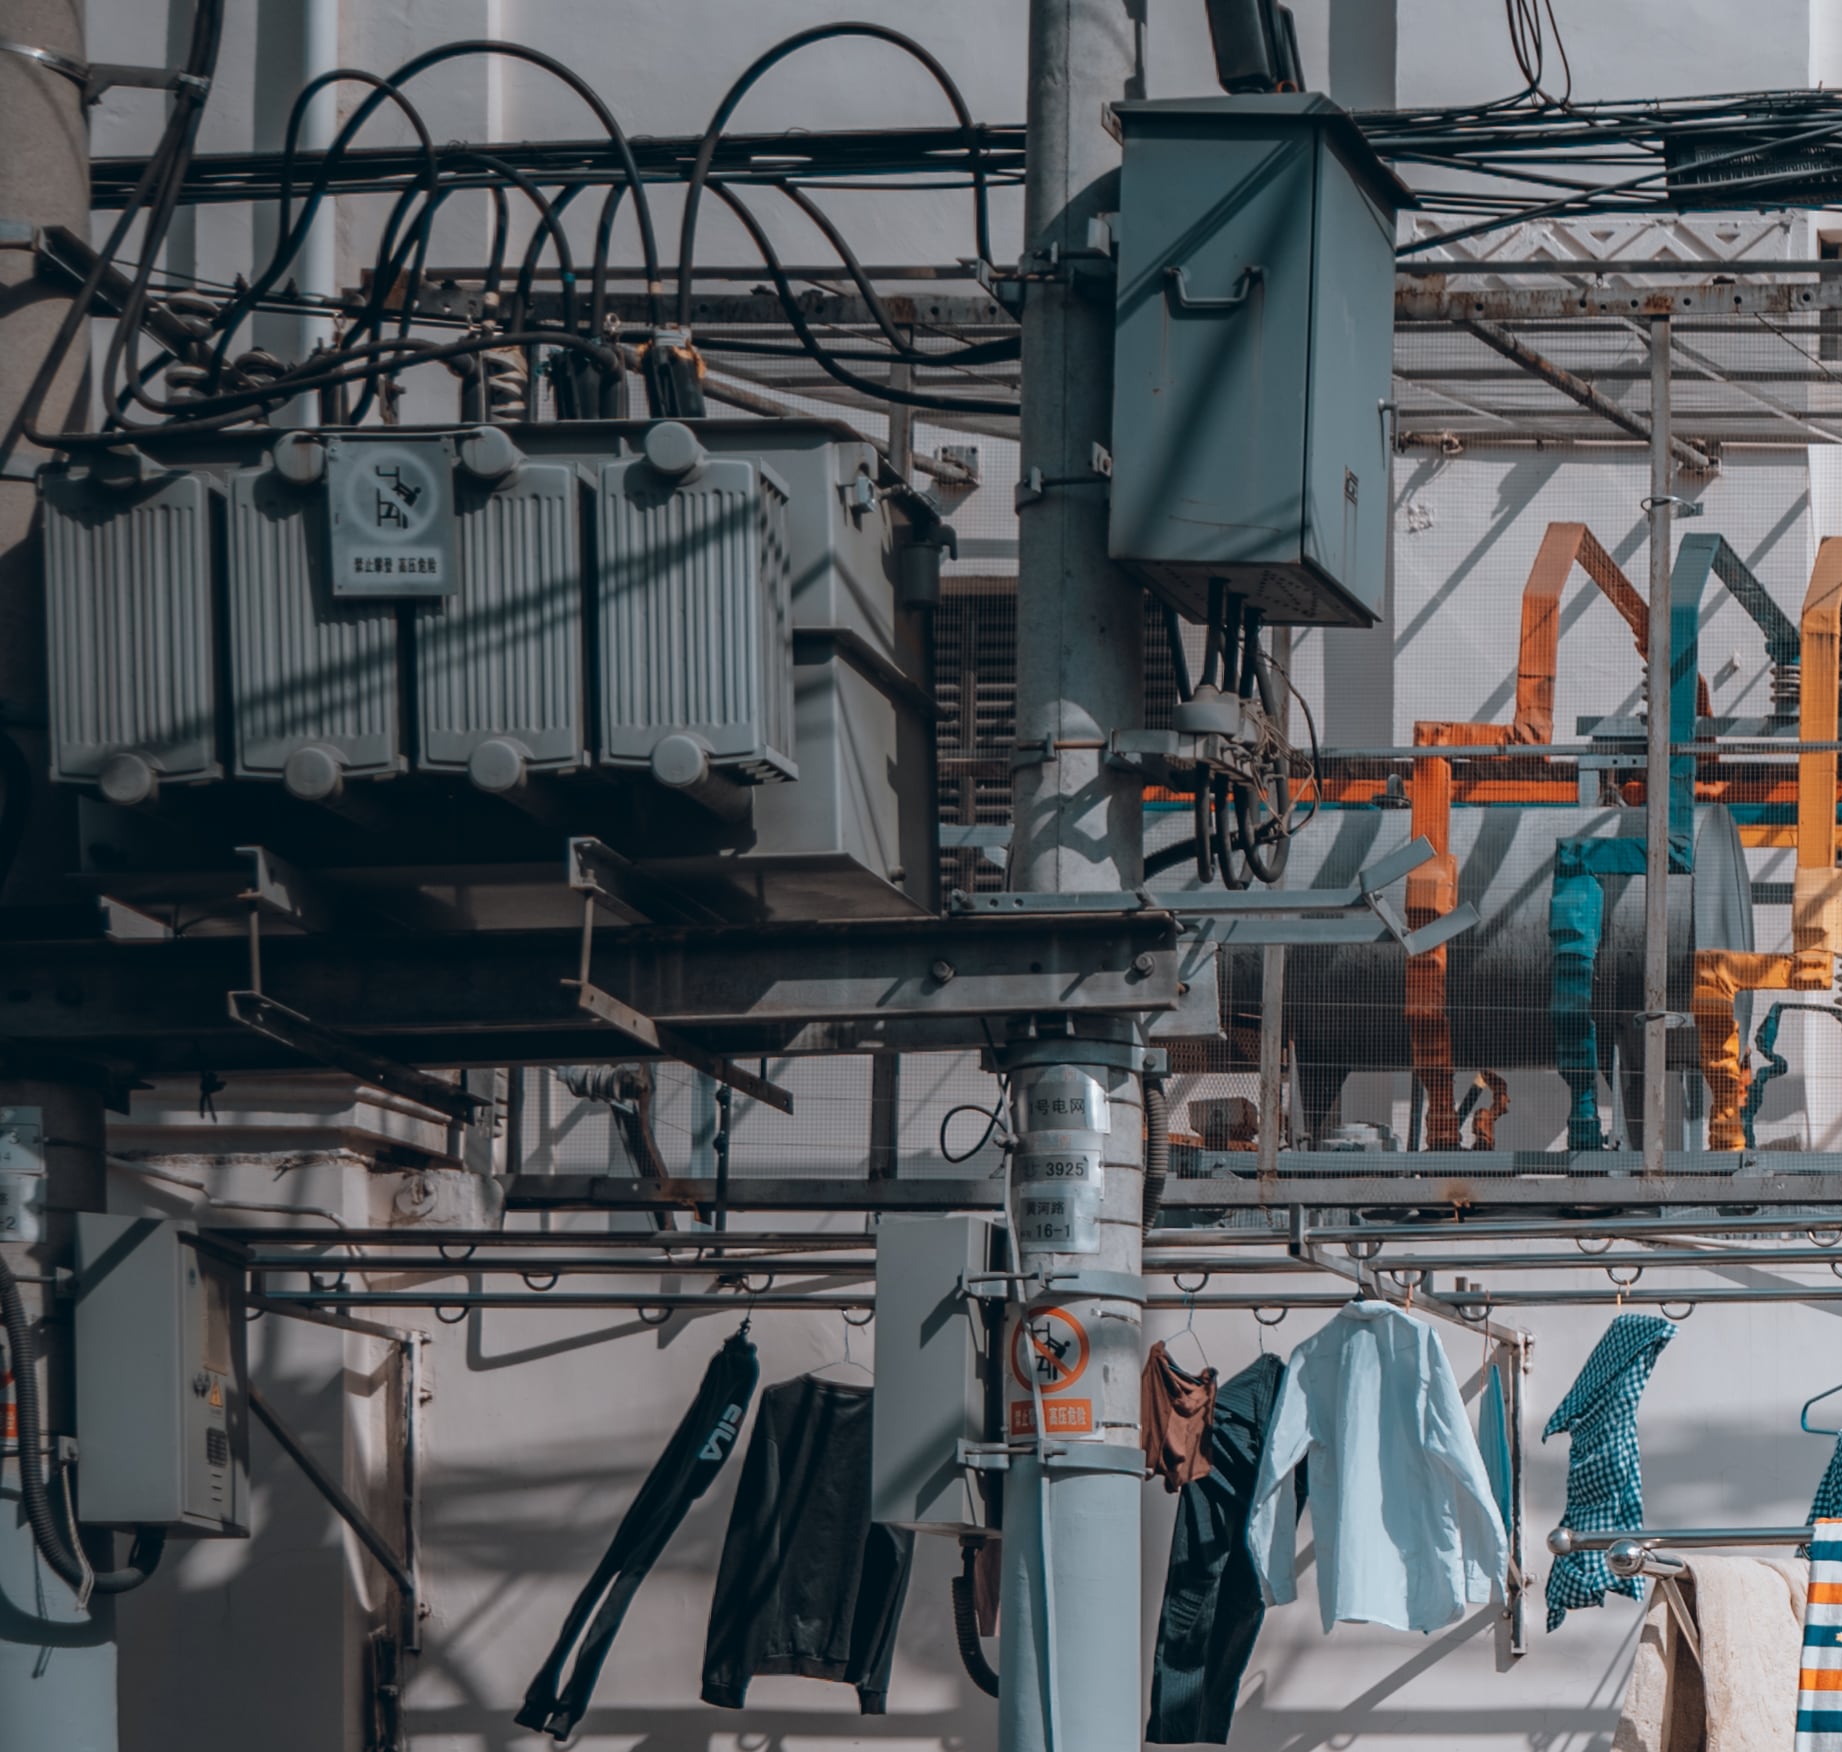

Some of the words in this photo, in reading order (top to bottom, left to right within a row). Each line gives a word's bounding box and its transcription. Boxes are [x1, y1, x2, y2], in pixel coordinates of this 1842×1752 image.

[1045, 1161, 1085, 1177] 3925
[1026, 1201, 1065, 1217] 黄河路
[1036, 1223, 1071, 1238] 16-1
